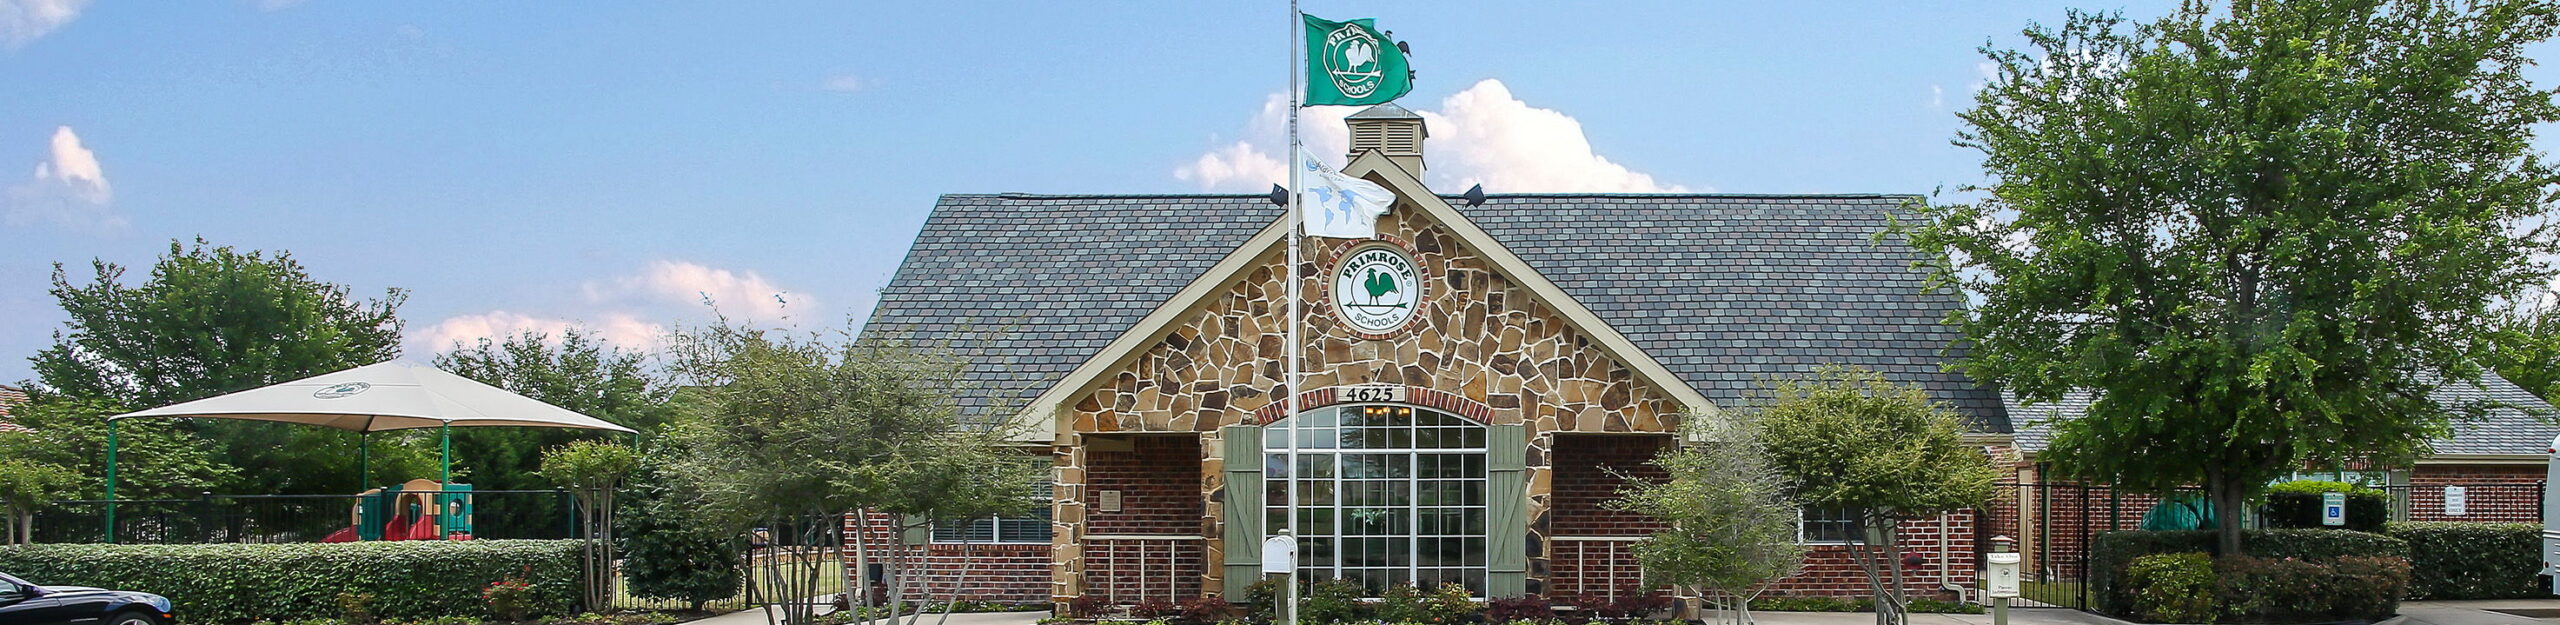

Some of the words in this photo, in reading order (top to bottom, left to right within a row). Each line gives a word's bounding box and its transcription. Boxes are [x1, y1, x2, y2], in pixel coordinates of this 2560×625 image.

[1338, 79, 1375, 95] SCHOOLS
[1342, 251, 1413, 281] PRIMROSE
[1354, 312, 1400, 328] SCHOOLS
[1346, 387, 1393, 402] 4625
